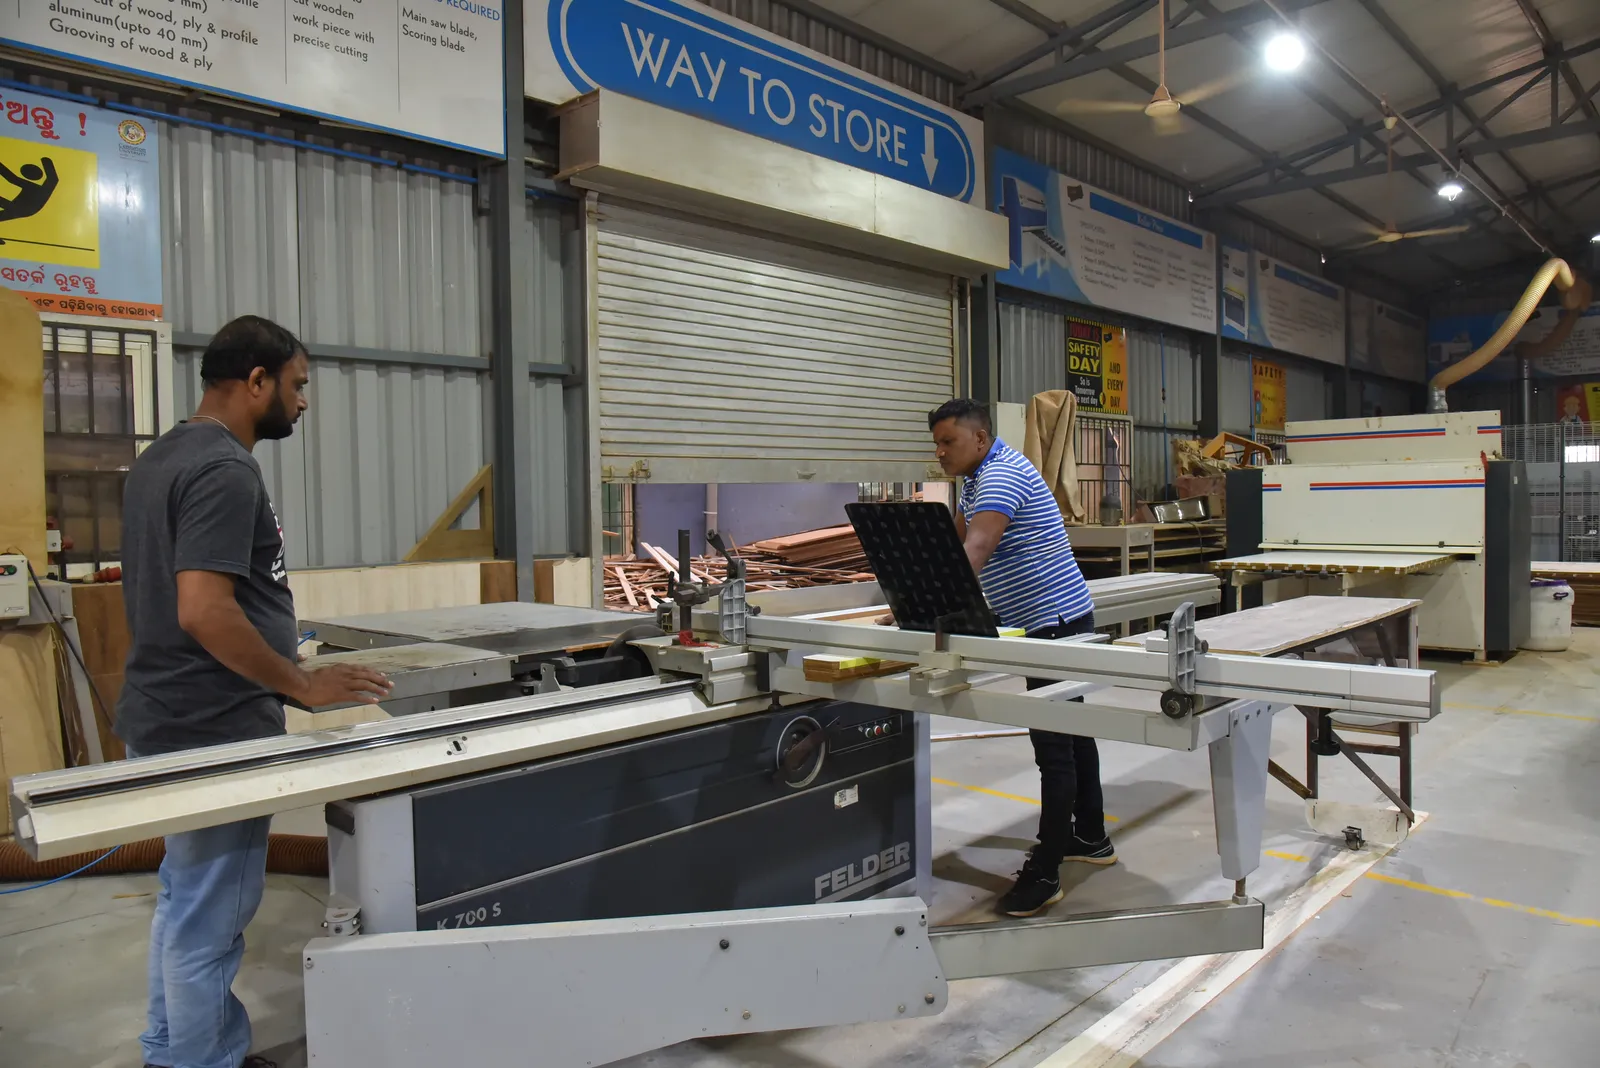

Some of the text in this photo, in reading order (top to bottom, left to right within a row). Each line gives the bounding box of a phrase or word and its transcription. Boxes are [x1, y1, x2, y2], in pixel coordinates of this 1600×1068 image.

[119, 0, 132, 12] of
[137, 6, 177, 25] wood,
[183, 16, 202, 32] ply
[207, 22, 216, 34] &
[221, 29, 259, 46] profile
[313, 1, 354, 20] wooden
[402, 7, 478, 41] Main saw blade,
[49, 2, 208, 52] aluminum(upto 40 mm)
[293, 13, 375, 44] work piece with
[402, 24, 466, 53] Scoring blade
[49, 17, 213, 71] Grooving of wood & ply
[293, 32, 368, 62] precise cutting
[620, 22, 909, 167] WAY TO STORE
[1068, 341, 1100, 357] SAFETY
[1069, 355, 1100, 373] DAY
[1109, 361, 1121, 374] AND
[1107, 378, 1123, 391] EVERY
[814, 841, 910, 900] FELDER
[436, 902, 502, 930] K 700 S
